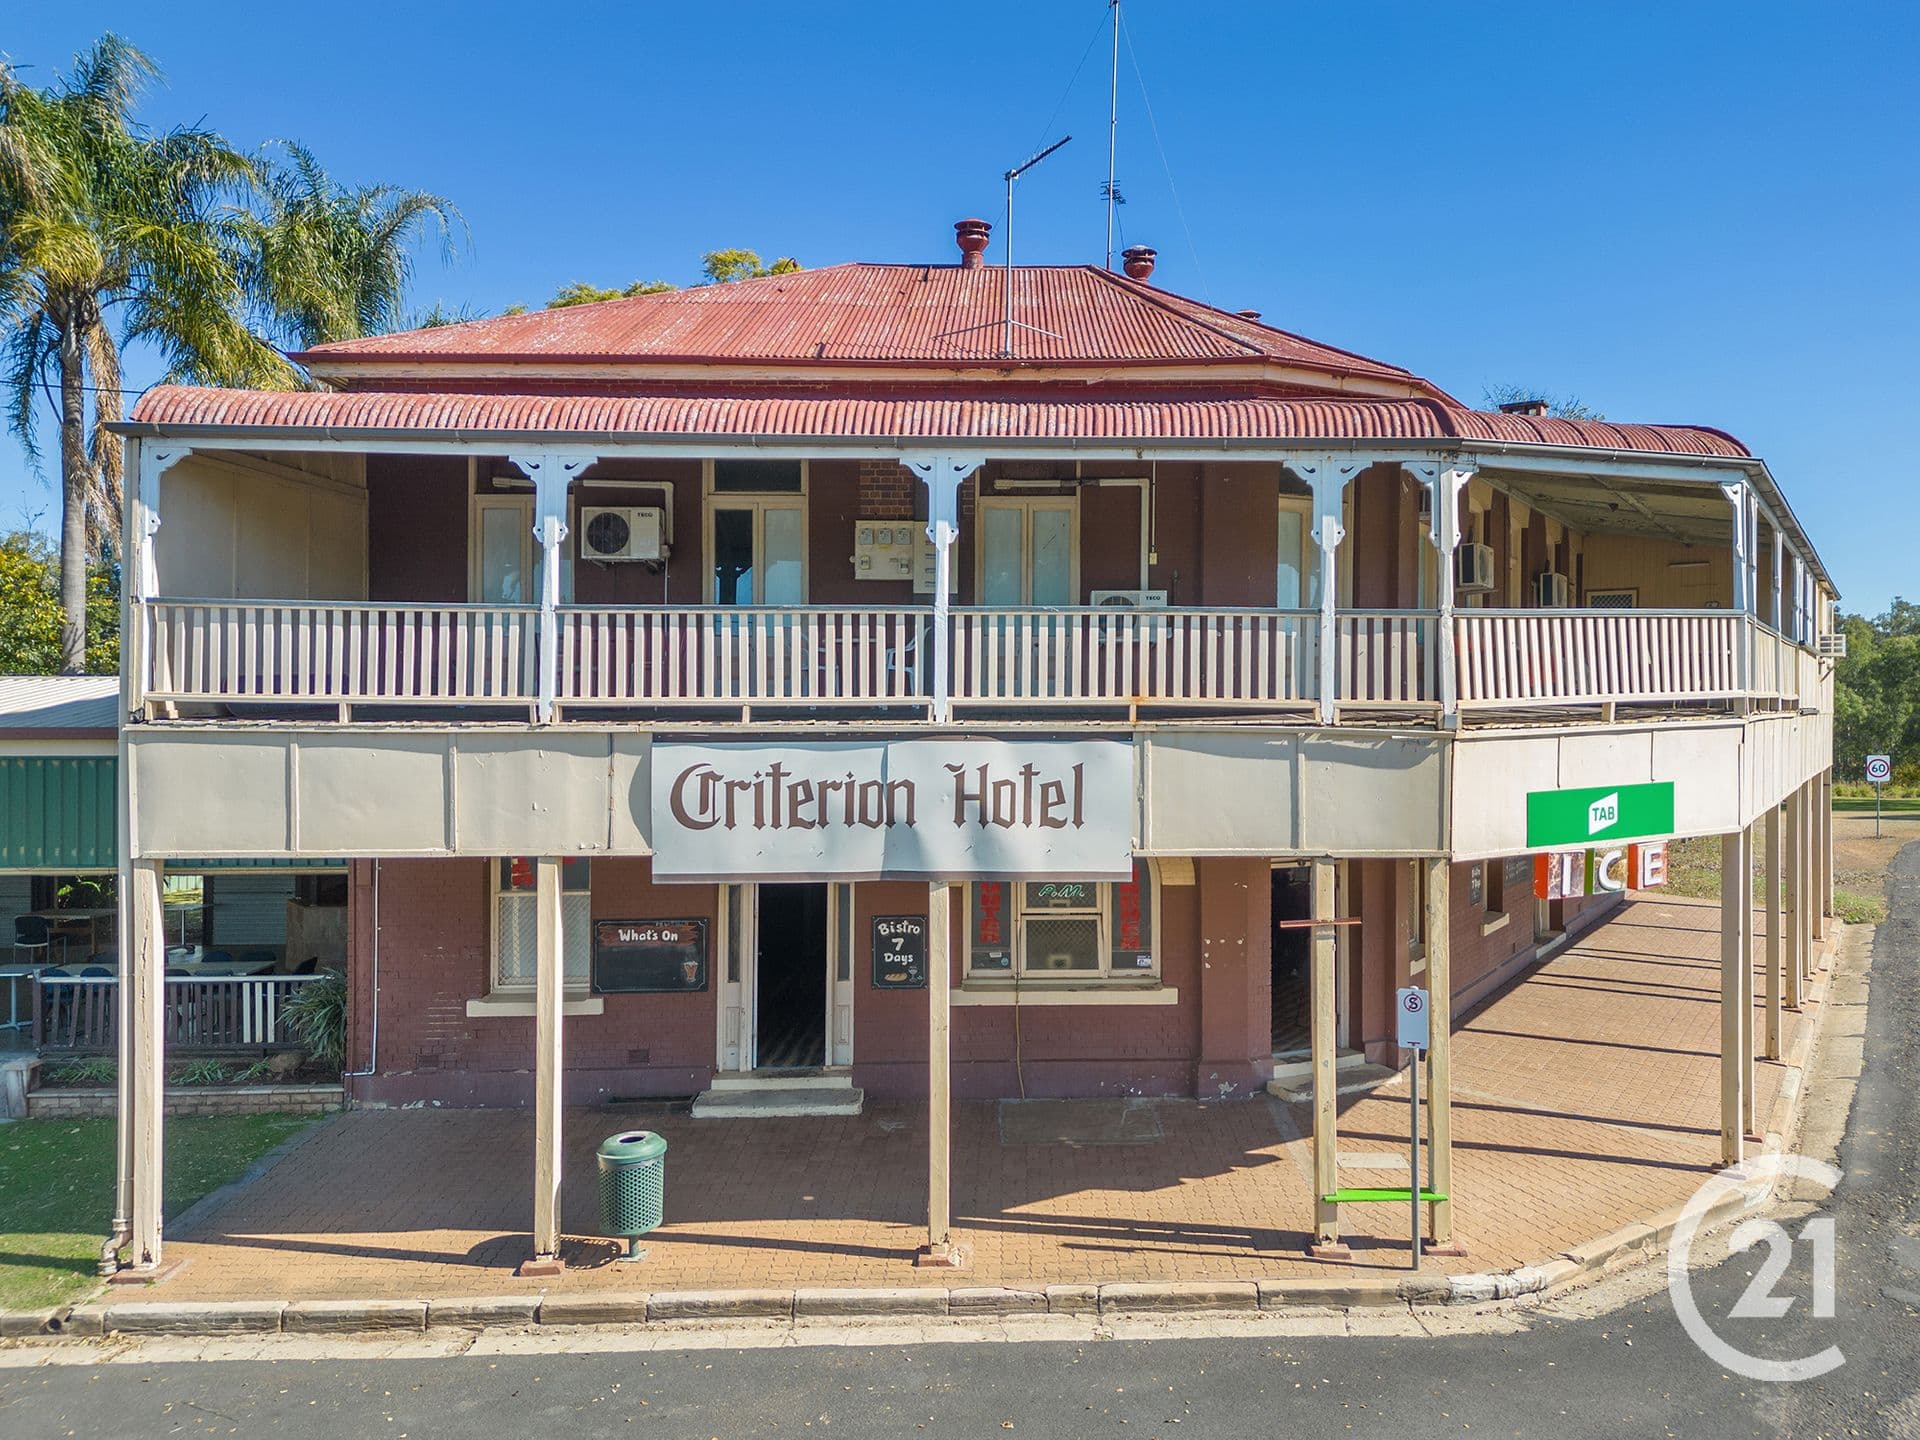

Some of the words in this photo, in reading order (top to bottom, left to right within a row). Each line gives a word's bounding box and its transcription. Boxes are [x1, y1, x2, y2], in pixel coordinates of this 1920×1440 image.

[1871, 763, 1886, 773] 60
[669, 761, 917, 831] Criterion
[943, 761, 1085, 830] Hotel
[1592, 806, 1616, 822] TAB
[1561, 846, 1664, 897] ICE
[618, 928, 659, 942] What's
[661, 929, 678, 942] On
[877, 919, 921, 936] Bistro
[891, 937, 905, 951] 7
[883, 952, 914, 966] Days
